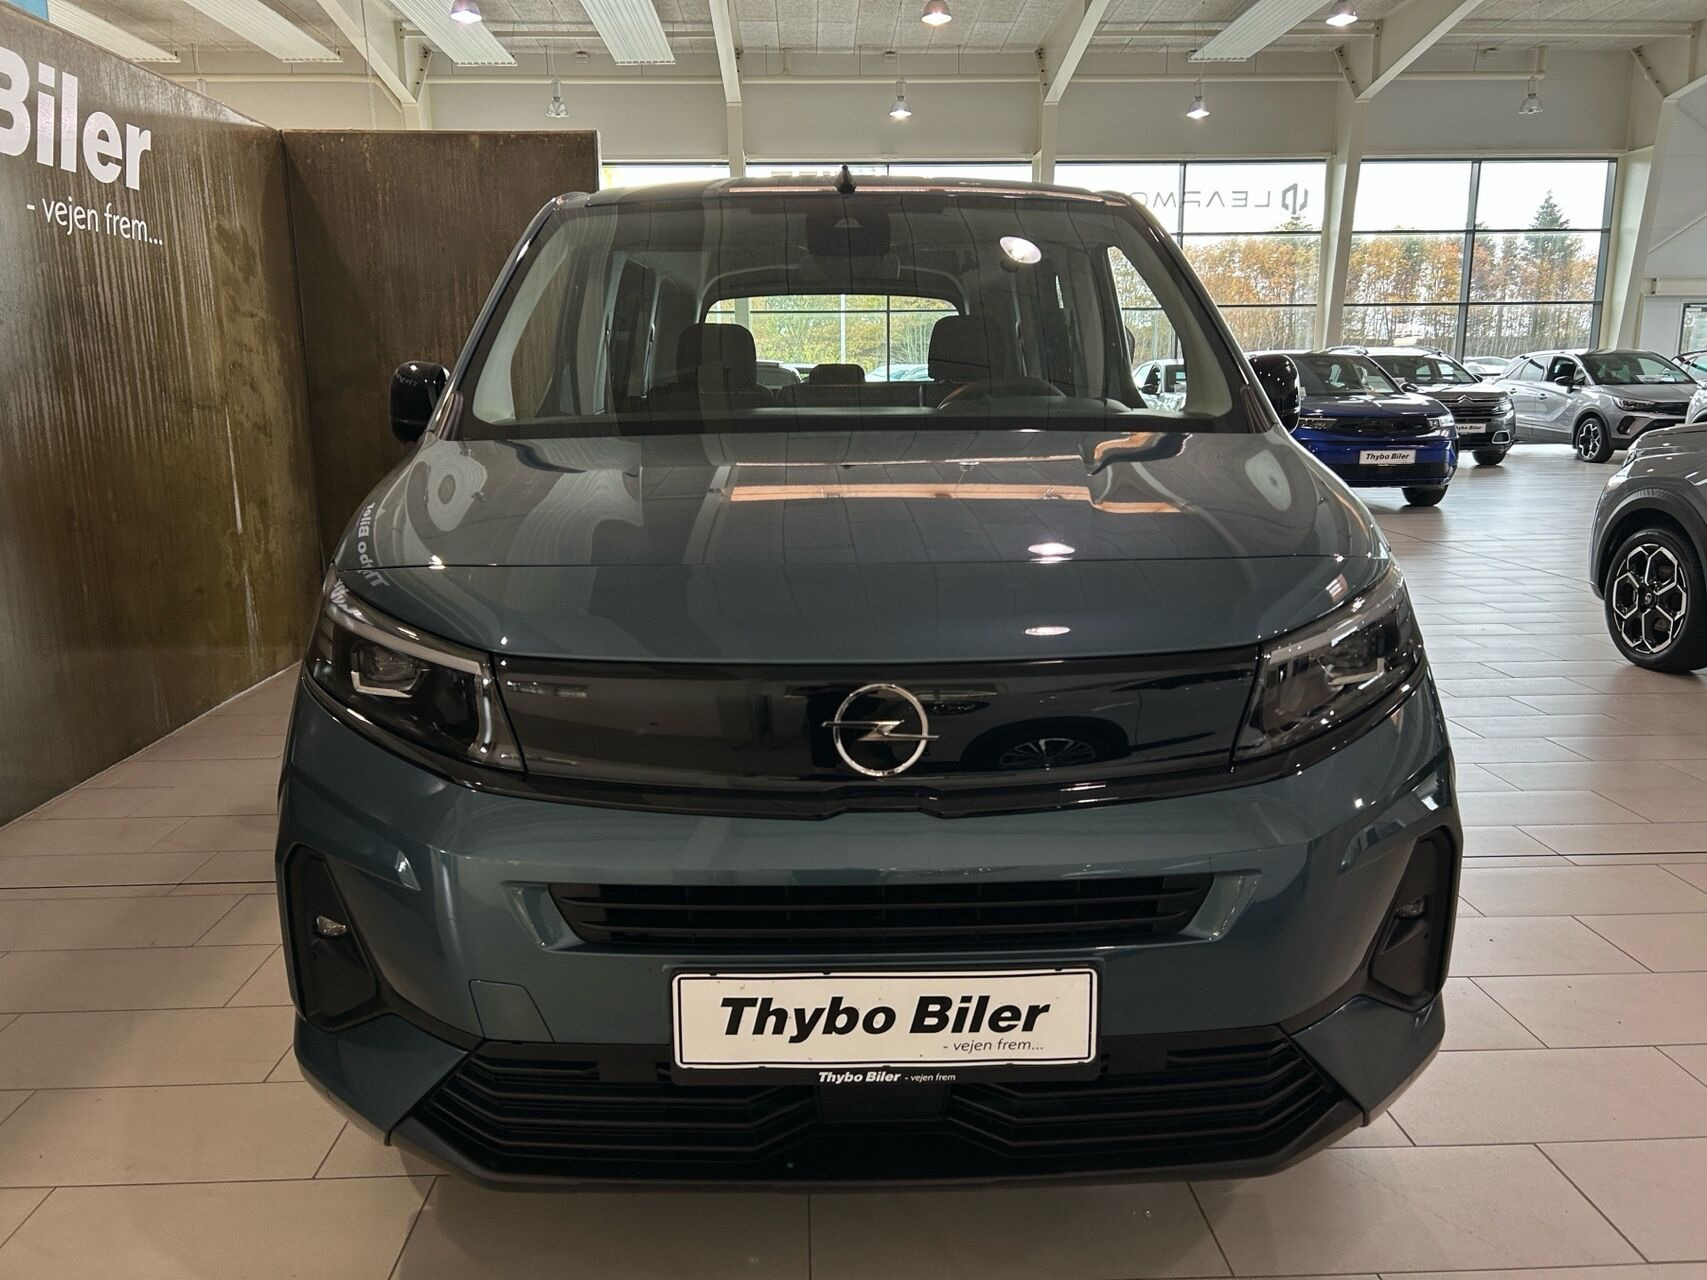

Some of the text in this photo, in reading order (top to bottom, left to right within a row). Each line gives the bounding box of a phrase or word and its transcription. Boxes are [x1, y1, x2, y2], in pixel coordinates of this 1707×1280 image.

[42, 196, 99, 236] vejen
[1366, 453, 1390, 461] Thybo
[721, 995, 1051, 1043] Thybo Biler
[953, 1040, 992, 1054] vejen
[997, 1038, 1044, 1051] frem...
[818, 1071, 863, 1084] Thybo
[865, 1071, 901, 1082] Biler
[910, 1073, 934, 1082] vejen
[936, 1072, 956, 1081] frem
